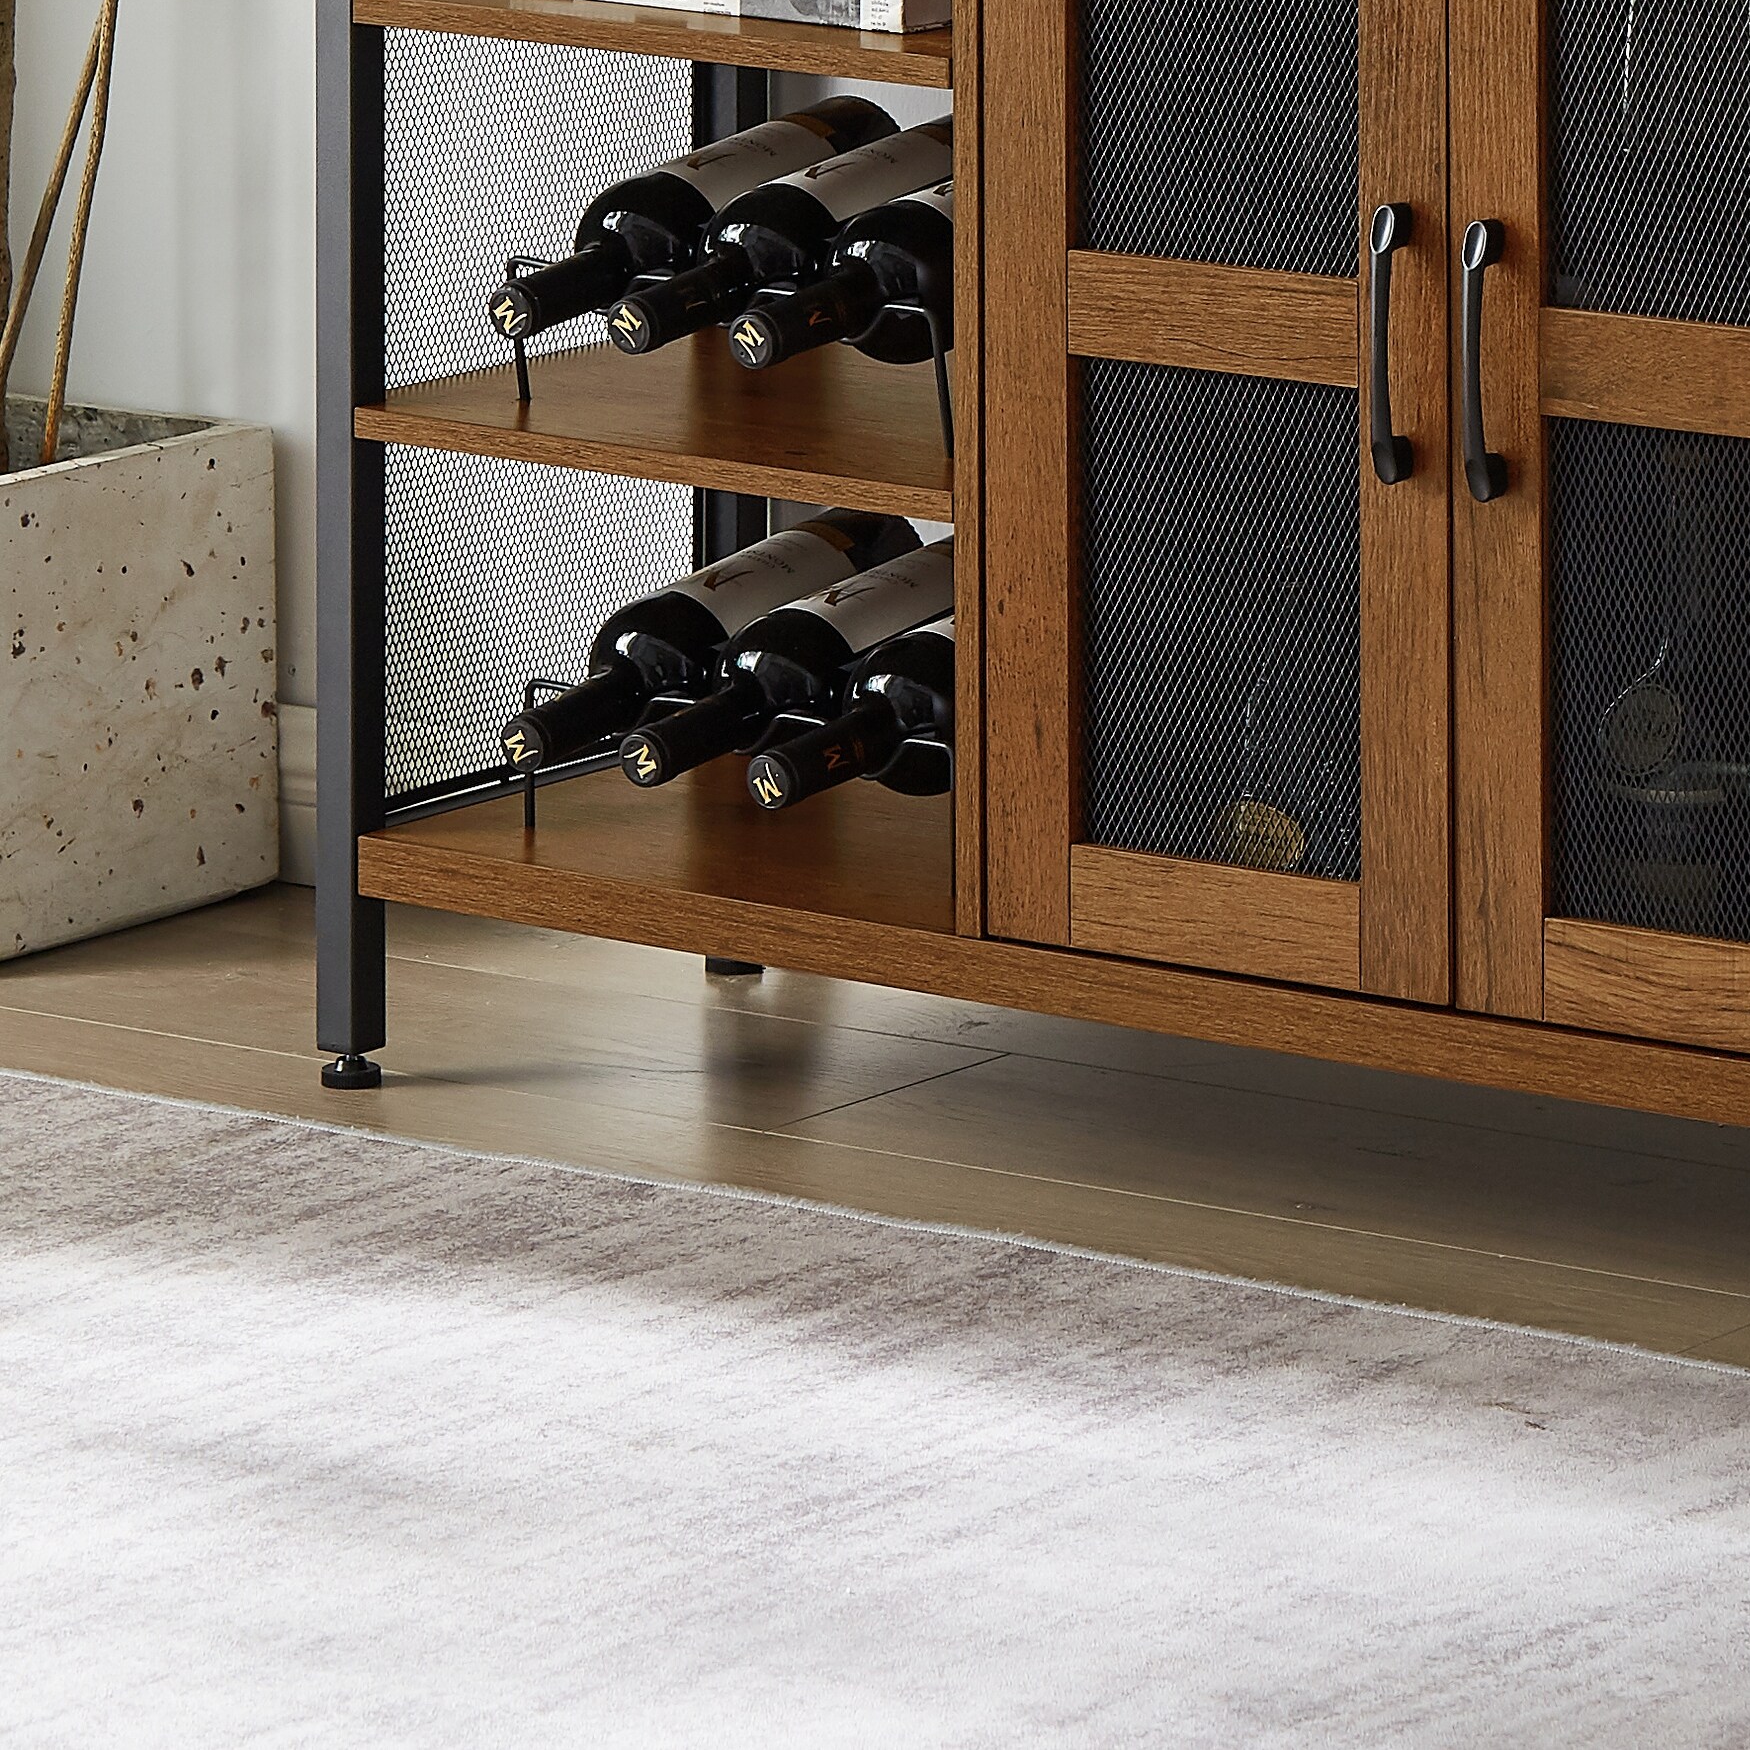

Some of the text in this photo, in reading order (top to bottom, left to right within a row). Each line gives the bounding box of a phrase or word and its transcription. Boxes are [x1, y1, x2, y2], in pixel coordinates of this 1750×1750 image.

[611, 304, 643, 349] M
[733, 320, 766, 364] M
[622, 743, 658, 780] M
